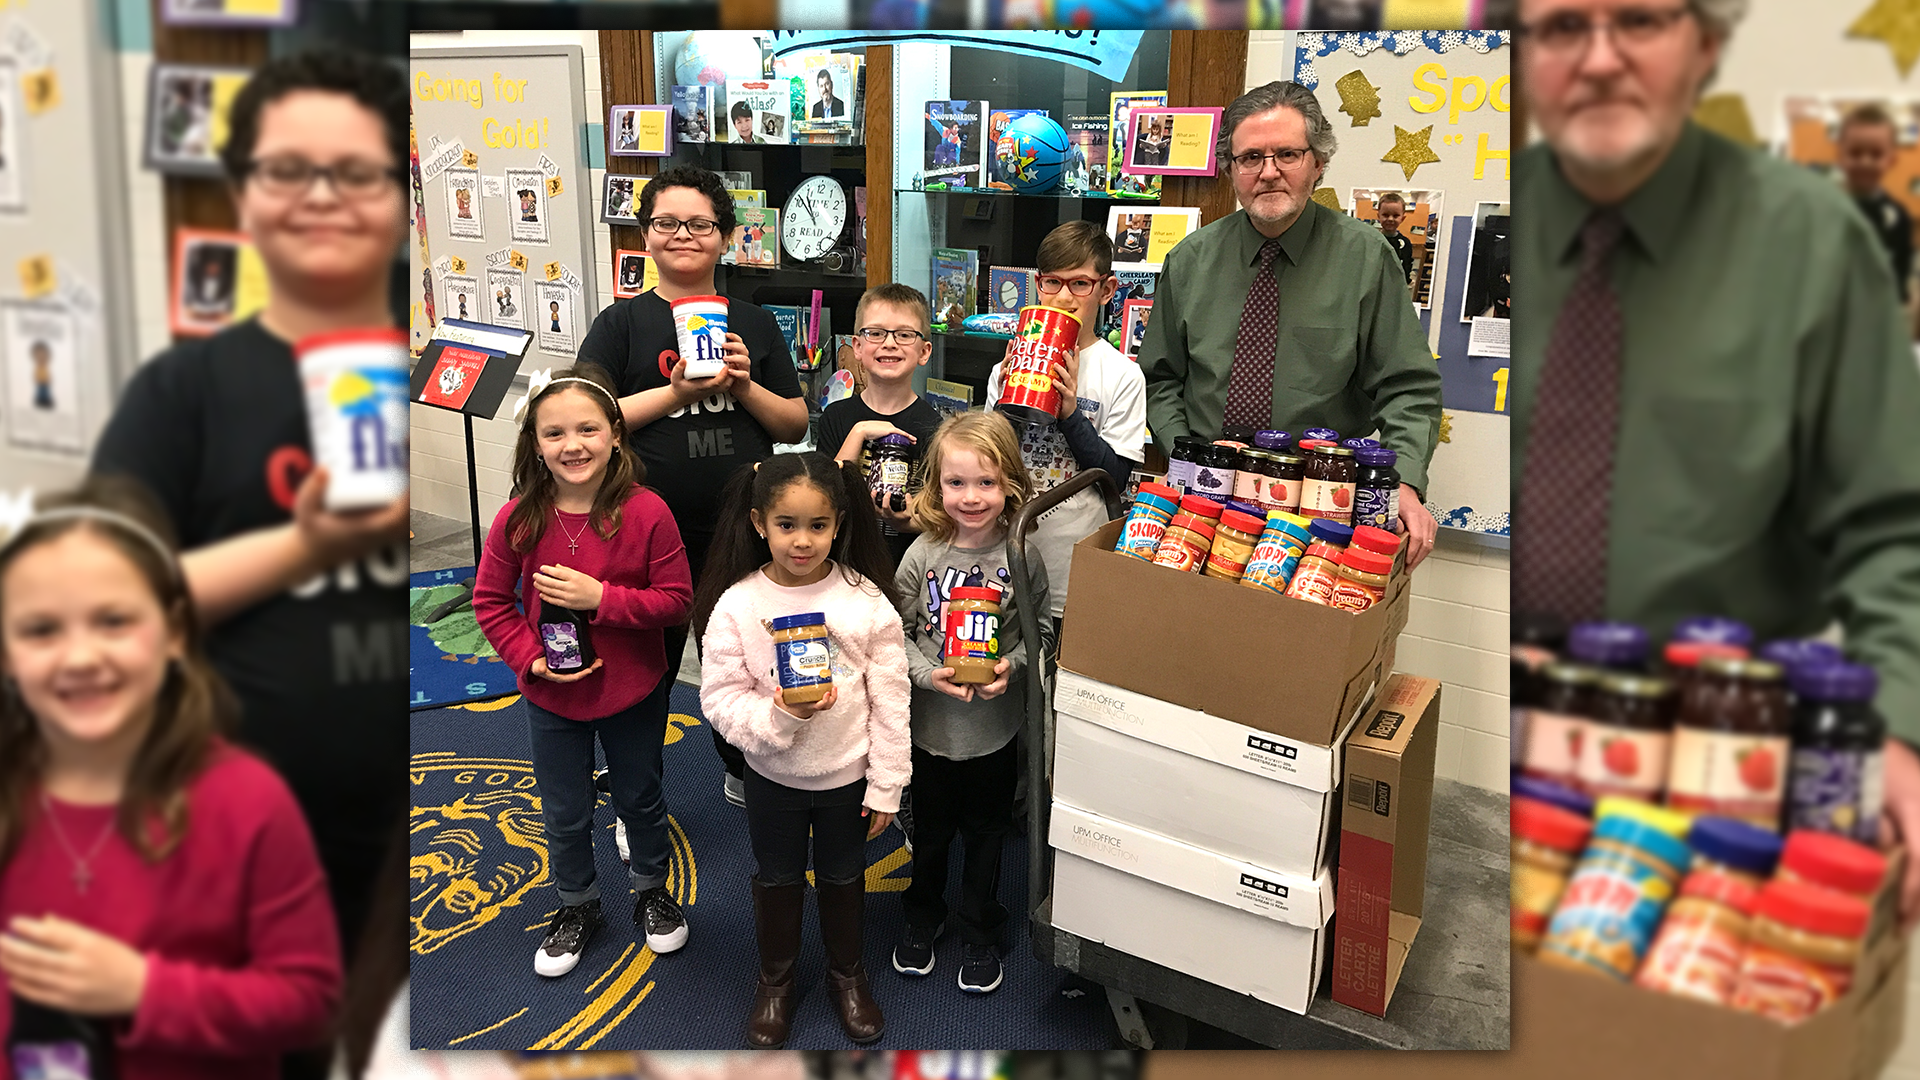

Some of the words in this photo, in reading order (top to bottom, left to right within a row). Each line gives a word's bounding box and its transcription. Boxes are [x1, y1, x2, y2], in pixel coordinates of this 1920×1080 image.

[415, 71, 483, 109] Going
[493, 72, 527, 103] for
[741, 96, 776, 110] Atlas?
[482, 117, 549, 149] Gold!
[1083, 122, 1108, 131] Fishing
[817, 184, 826, 194] 12
[830, 189, 834, 198] 1
[833, 200, 840, 210] 2
[790, 213, 797, 222] 9
[833, 215, 839, 225] 3
[789, 228, 796, 237] 8
[800, 228, 823, 237] READ
[795, 239, 801, 249] 7
[804, 245, 811, 254] 6
[543, 287, 565, 302] Honesty
[1012, 336, 1058, 360] Peter
[1011, 375, 1049, 388] CREAMY
[687, 427, 735, 458] ME
[1260, 500, 1293, 513] STRAWBERRY
[1213, 556, 1236, 569] CREAMY
[1335, 592, 1368, 608] Creamy
[956, 614, 998, 641] Jif
[1076, 688, 1095, 700] UPM
[1097, 694, 1126, 711] OFFICE
[1076, 698, 1145, 726] MULTIFUNCTION
[1370, 712, 1400, 738] Report
[454, 771, 538, 790] GOD
[1376, 784, 1389, 813] Report
[1073, 825, 1092, 838] UPM
[1093, 831, 1122, 848] OFFICE
[1071, 835, 1139, 863] MULTIFUNCTION
[1340, 936, 1353, 989] LETTER
[1353, 942, 1367, 992] CARTA
[1367, 945, 1381, 999] LETTRE
